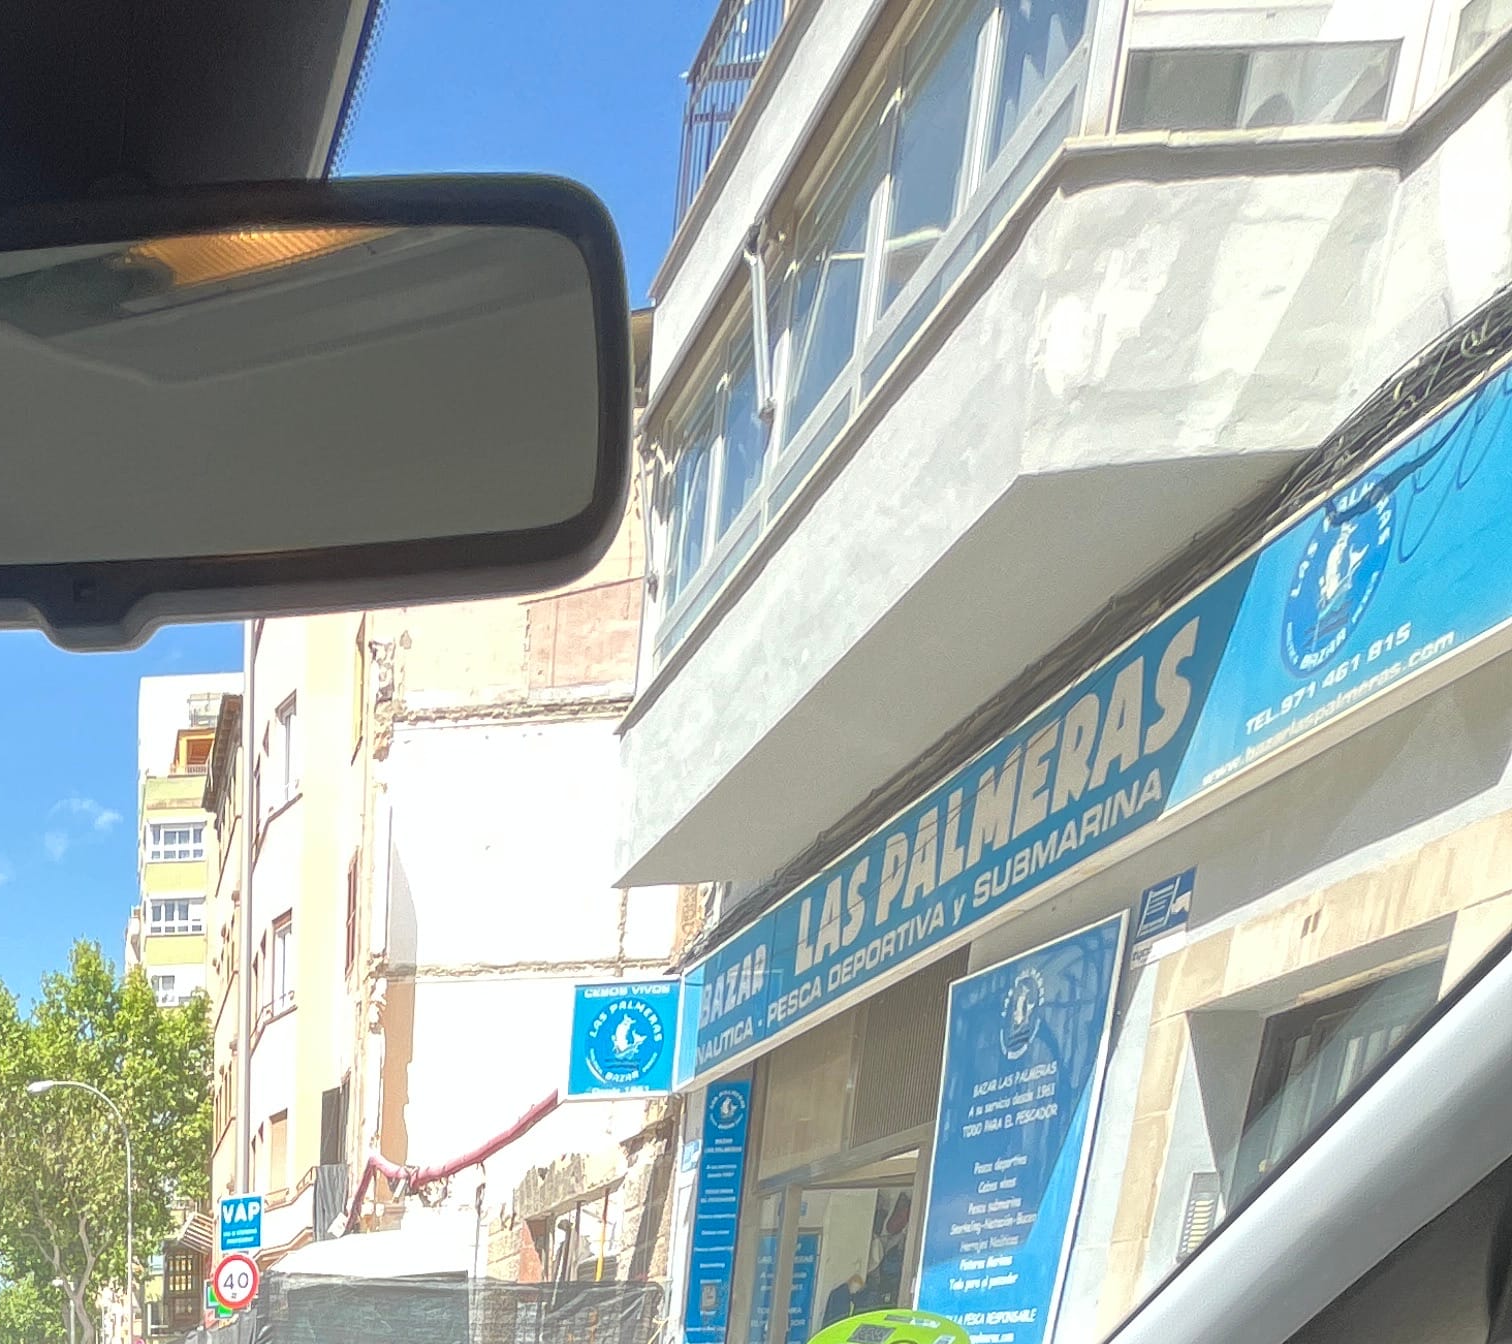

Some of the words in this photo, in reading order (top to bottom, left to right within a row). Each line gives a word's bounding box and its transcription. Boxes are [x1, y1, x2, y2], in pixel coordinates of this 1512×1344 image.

[1322, 654, 1361, 690] 461
[1367, 621, 1412, 662] 815
[795, 857, 870, 976] LAS
[874, 616, 1200, 927] PALMERAS
[767, 975, 823, 1028] PESCA
[827, 901, 945, 993] DEPORTIVA
[952, 893, 968, 927] y
[973, 767, 1163, 909] SUBMARINA
[589, 1011, 608, 1038] LAS
[609, 1000, 663, 1042] PALMERAS
[699, 944, 767, 1029] BAZAR
[222, 1202, 261, 1224] VAP
[223, 1272, 249, 1290] 40
